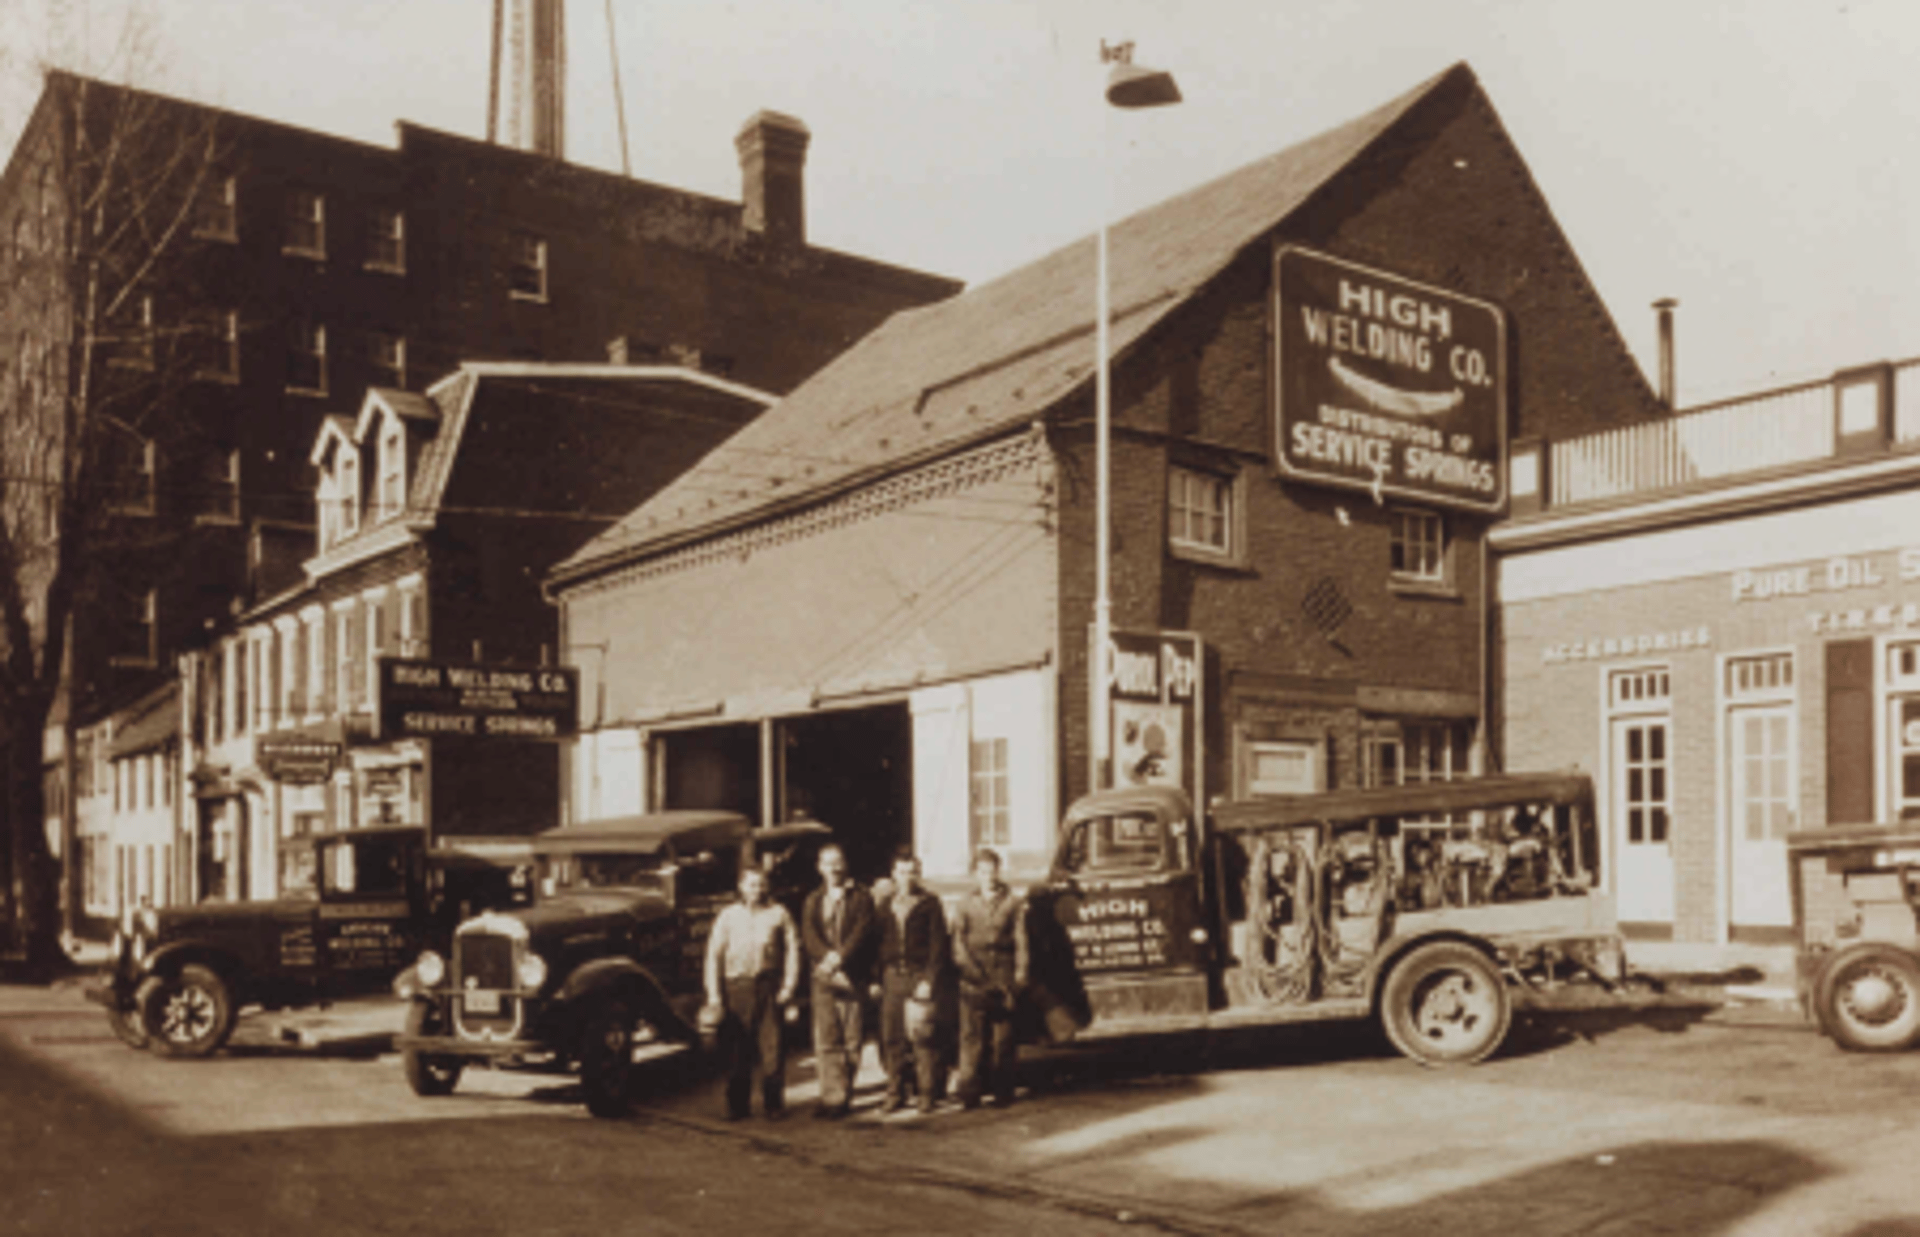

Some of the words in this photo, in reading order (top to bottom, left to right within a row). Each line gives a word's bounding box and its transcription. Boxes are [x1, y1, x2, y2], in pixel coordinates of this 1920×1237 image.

[1338, 280, 1451, 338] HIGH
[1302, 305, 1432, 373] WELDING
[1450, 345, 1493, 387] CO.
[1291, 421, 1393, 474] SERVICE
[1404, 446, 1495, 492] SPRINGS
[1731, 567, 1809, 602] PURE
[1826, 556, 1883, 589] OIL
[394, 665, 441, 687] HIGH
[448, 668, 533, 692] WELDING
[404, 712, 475, 734] SERVICE
[485, 715, 556, 735] SPRINGS
[1078, 899, 1148, 922] HIGH
